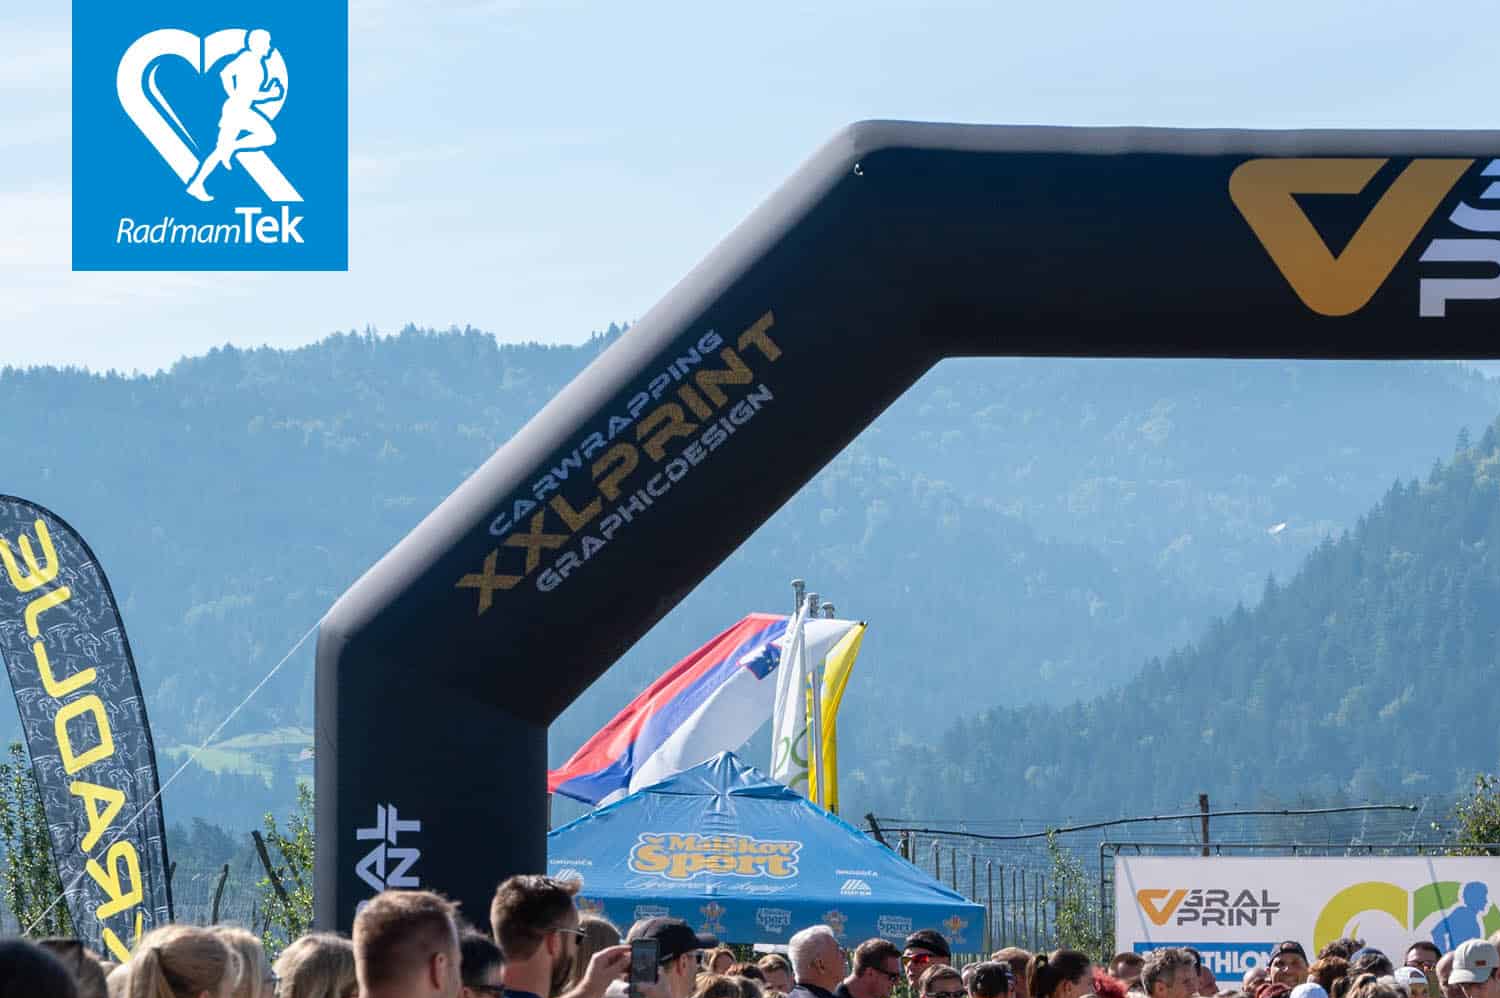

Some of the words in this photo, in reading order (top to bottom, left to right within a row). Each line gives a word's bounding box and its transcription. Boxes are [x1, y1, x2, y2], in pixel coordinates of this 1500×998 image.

[455, 311, 785, 616] XXLPRINT
[489, 328, 723, 537] CARWRAPPING
[536, 383, 774, 593] GRAPHICDESIGN
[1176, 907, 1281, 927] PRINT
